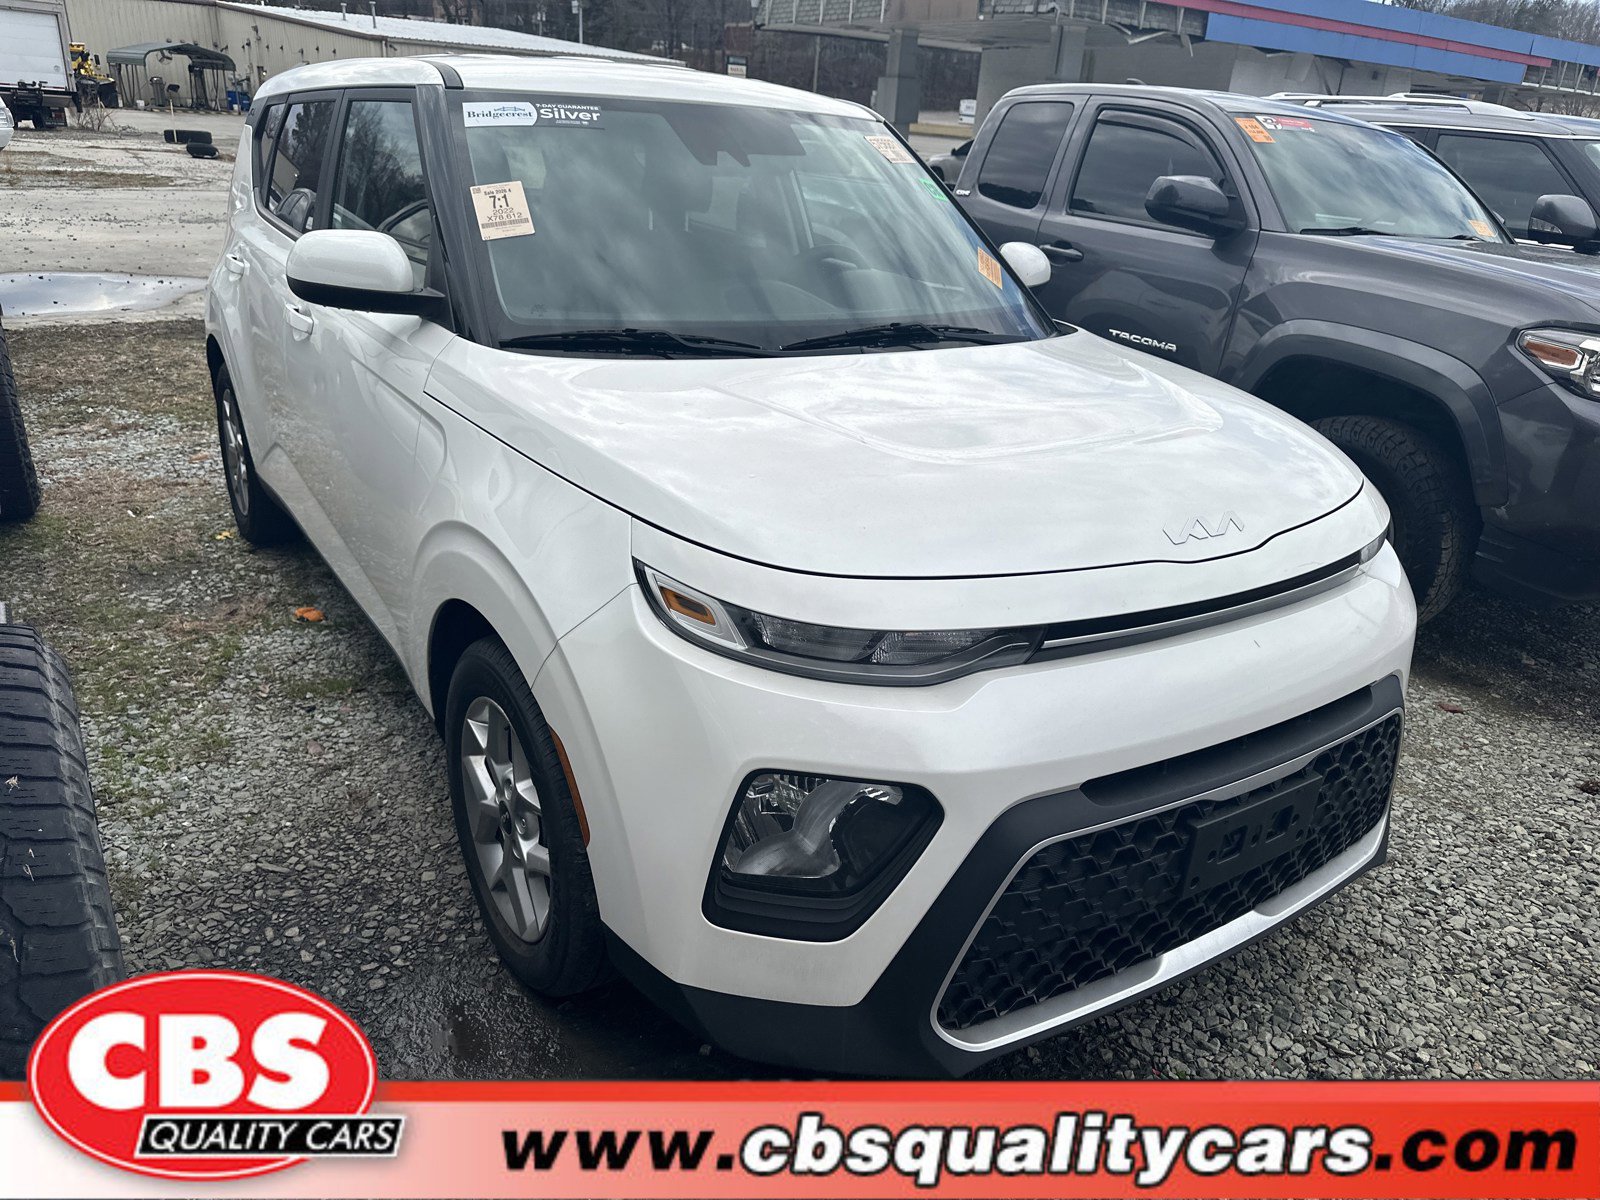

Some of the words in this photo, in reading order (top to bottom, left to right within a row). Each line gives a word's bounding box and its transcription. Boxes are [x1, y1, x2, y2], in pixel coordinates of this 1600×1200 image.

[466, 110, 533, 119] Bridgecrest
[540, 107, 601, 121] Silver
[489, 193, 509, 209] 7:1
[493, 207, 514, 216] 2022
[1108, 328, 1177, 352] TACOMA
